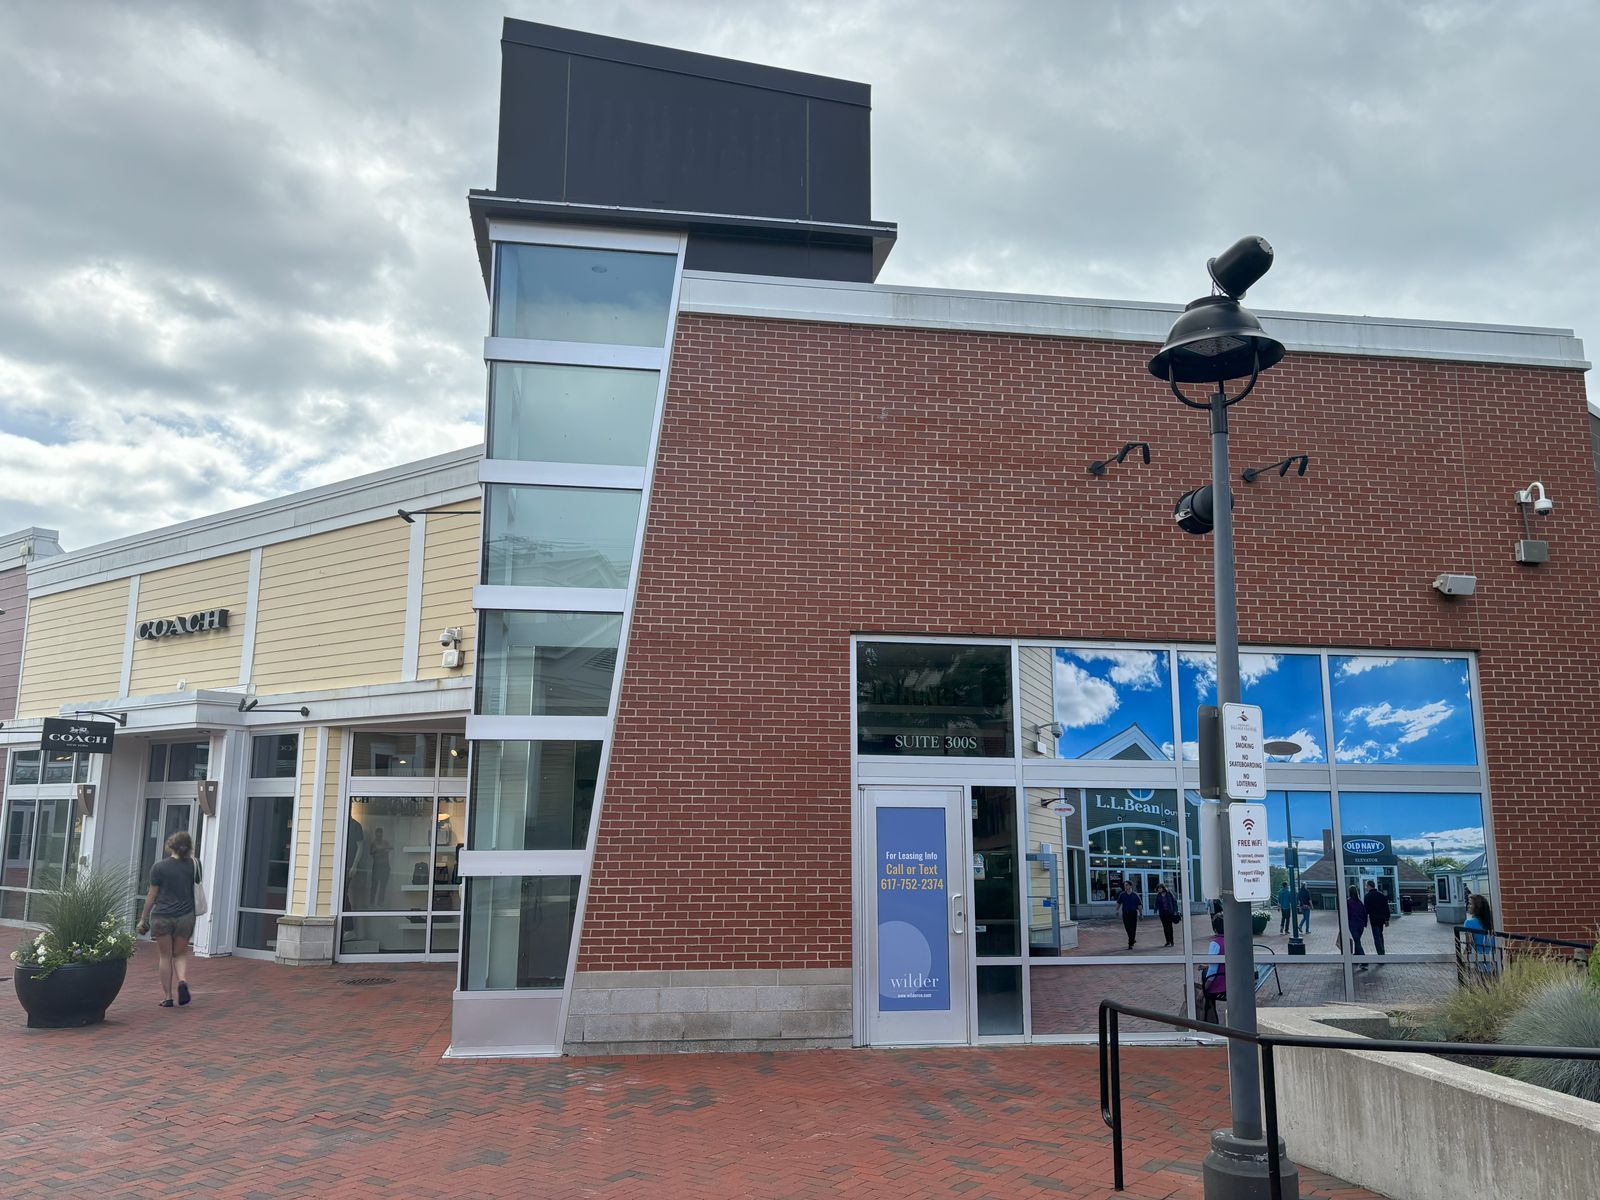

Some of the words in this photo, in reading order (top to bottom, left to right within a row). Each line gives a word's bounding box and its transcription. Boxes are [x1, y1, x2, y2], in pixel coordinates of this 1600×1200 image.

[136, 609, 226, 640] COACH
[48, 733, 108, 744] COACH
[894, 734, 940, 749] SUITE
[944, 735, 978, 750] 300S
[1235, 742, 1254, 750] SMOKING
[1229, 761, 1262, 769] SKATEBOARDING
[1095, 794, 1161, 815] L.L.Bean
[1237, 839, 1251, 847] FREE
[1361, 842, 1380, 850] NAVY
[885, 851, 897, 860] For
[898, 851, 924, 862] Leasing
[924, 851, 938, 860] Info
[886, 863, 904, 875] Call
[906, 866, 916, 875] or
[918, 863, 938, 875] Text
[880, 878, 944, 890] 617-752-2374
[890, 972, 939, 988] wilder
